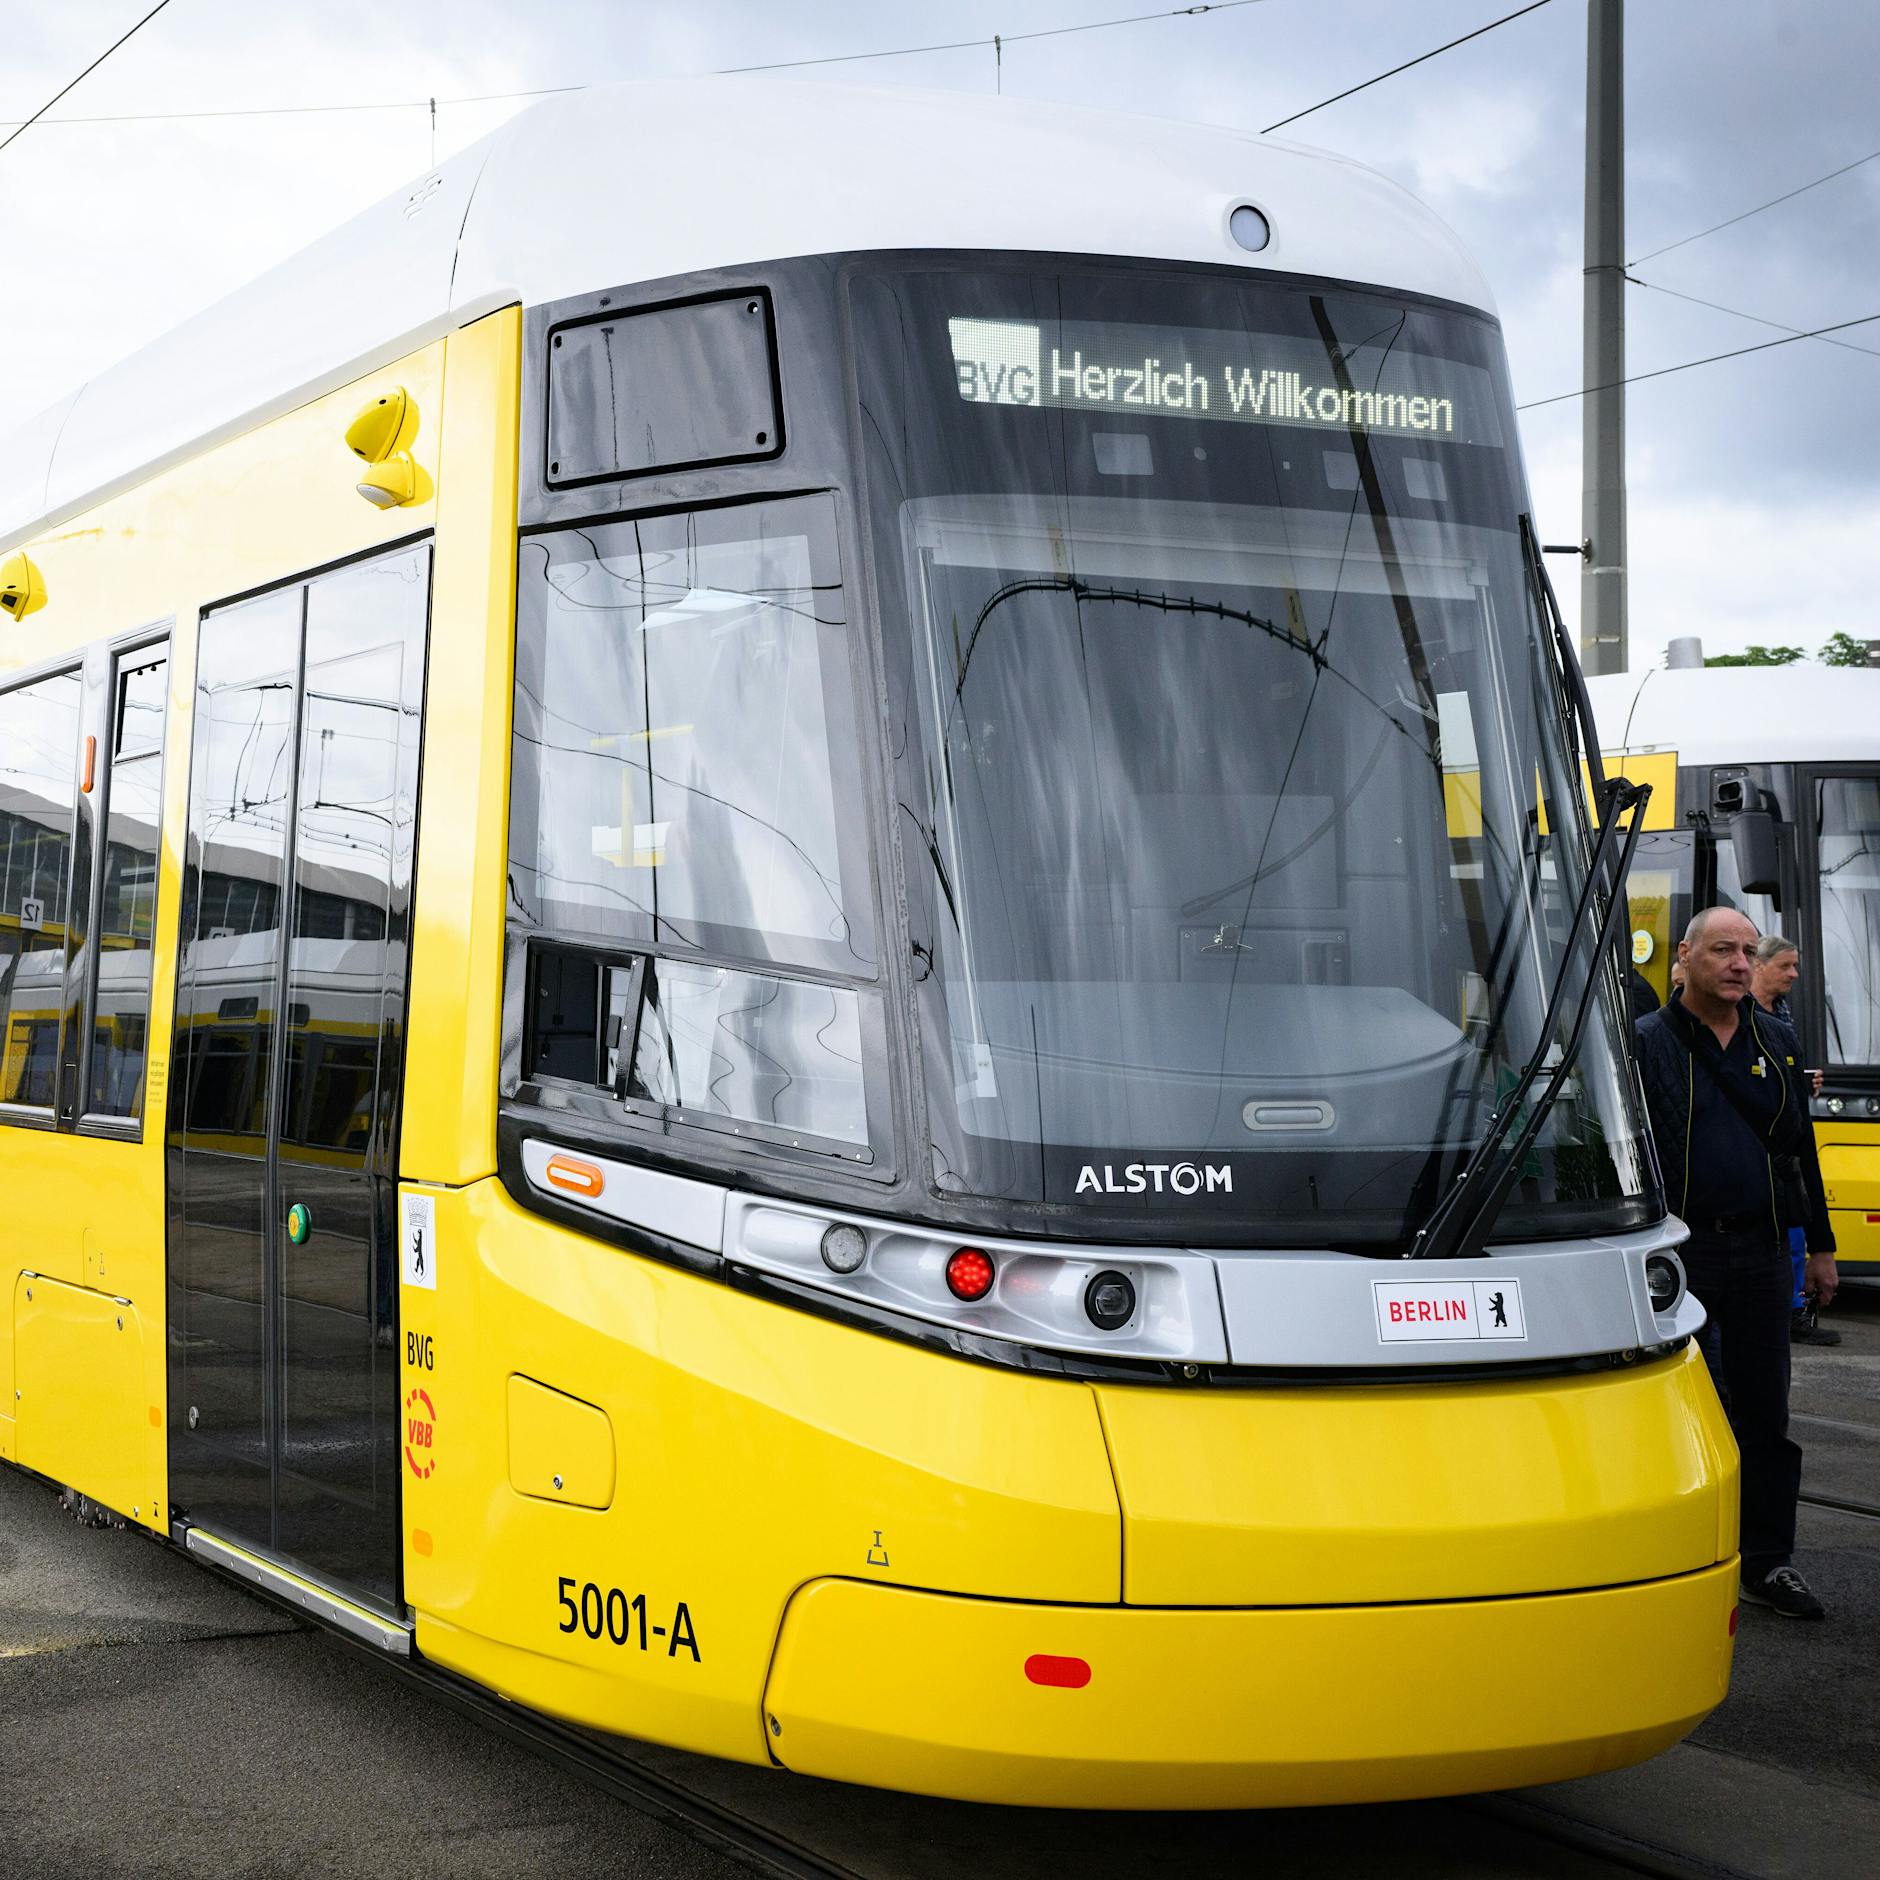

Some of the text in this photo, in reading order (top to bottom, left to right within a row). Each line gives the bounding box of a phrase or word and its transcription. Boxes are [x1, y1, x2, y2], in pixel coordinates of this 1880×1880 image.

[956, 349, 1453, 432] BVG Herzlich Willkommen
[1075, 1161, 1233, 1196] ALSTOM
[1389, 1299, 1468, 1323] BERLIN
[406, 1331, 434, 1372] BVG
[407, 1417, 433, 1449] VBB
[558, 1576, 702, 1664] 5001-A
